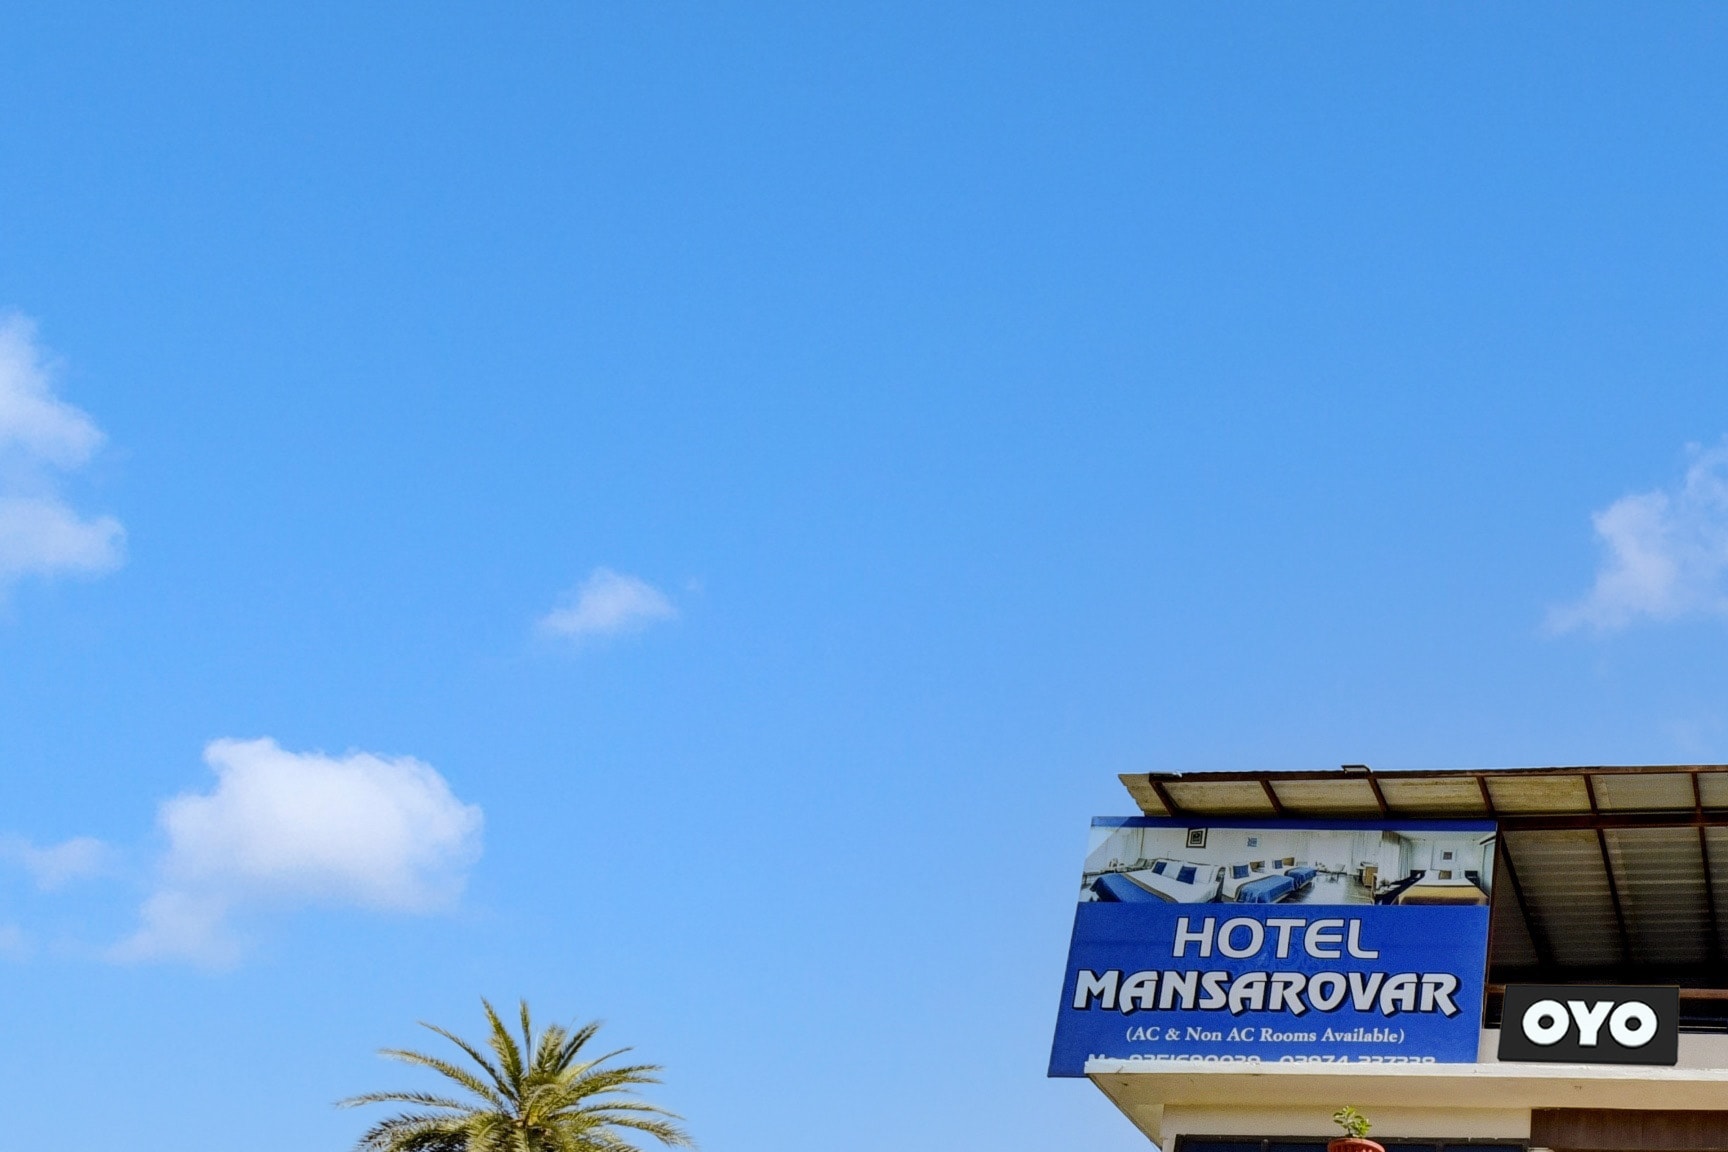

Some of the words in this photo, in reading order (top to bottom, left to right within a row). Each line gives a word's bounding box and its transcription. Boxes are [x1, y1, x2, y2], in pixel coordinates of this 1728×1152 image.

[1172, 917, 1379, 959] HOTEL
[1073, 969, 1459, 1017] MANSAROVAR
[1125, 1027, 1160, 1043] (AC
[1165, 1028, 1181, 1042] &
[1185, 1028, 1222, 1042] Non
[1227, 1028, 1255, 1042] AC
[1260, 1028, 1317, 1042] Rooms
[1322, 1028, 1405, 1044] Available)
[1522, 1000, 1658, 1048] OYO
